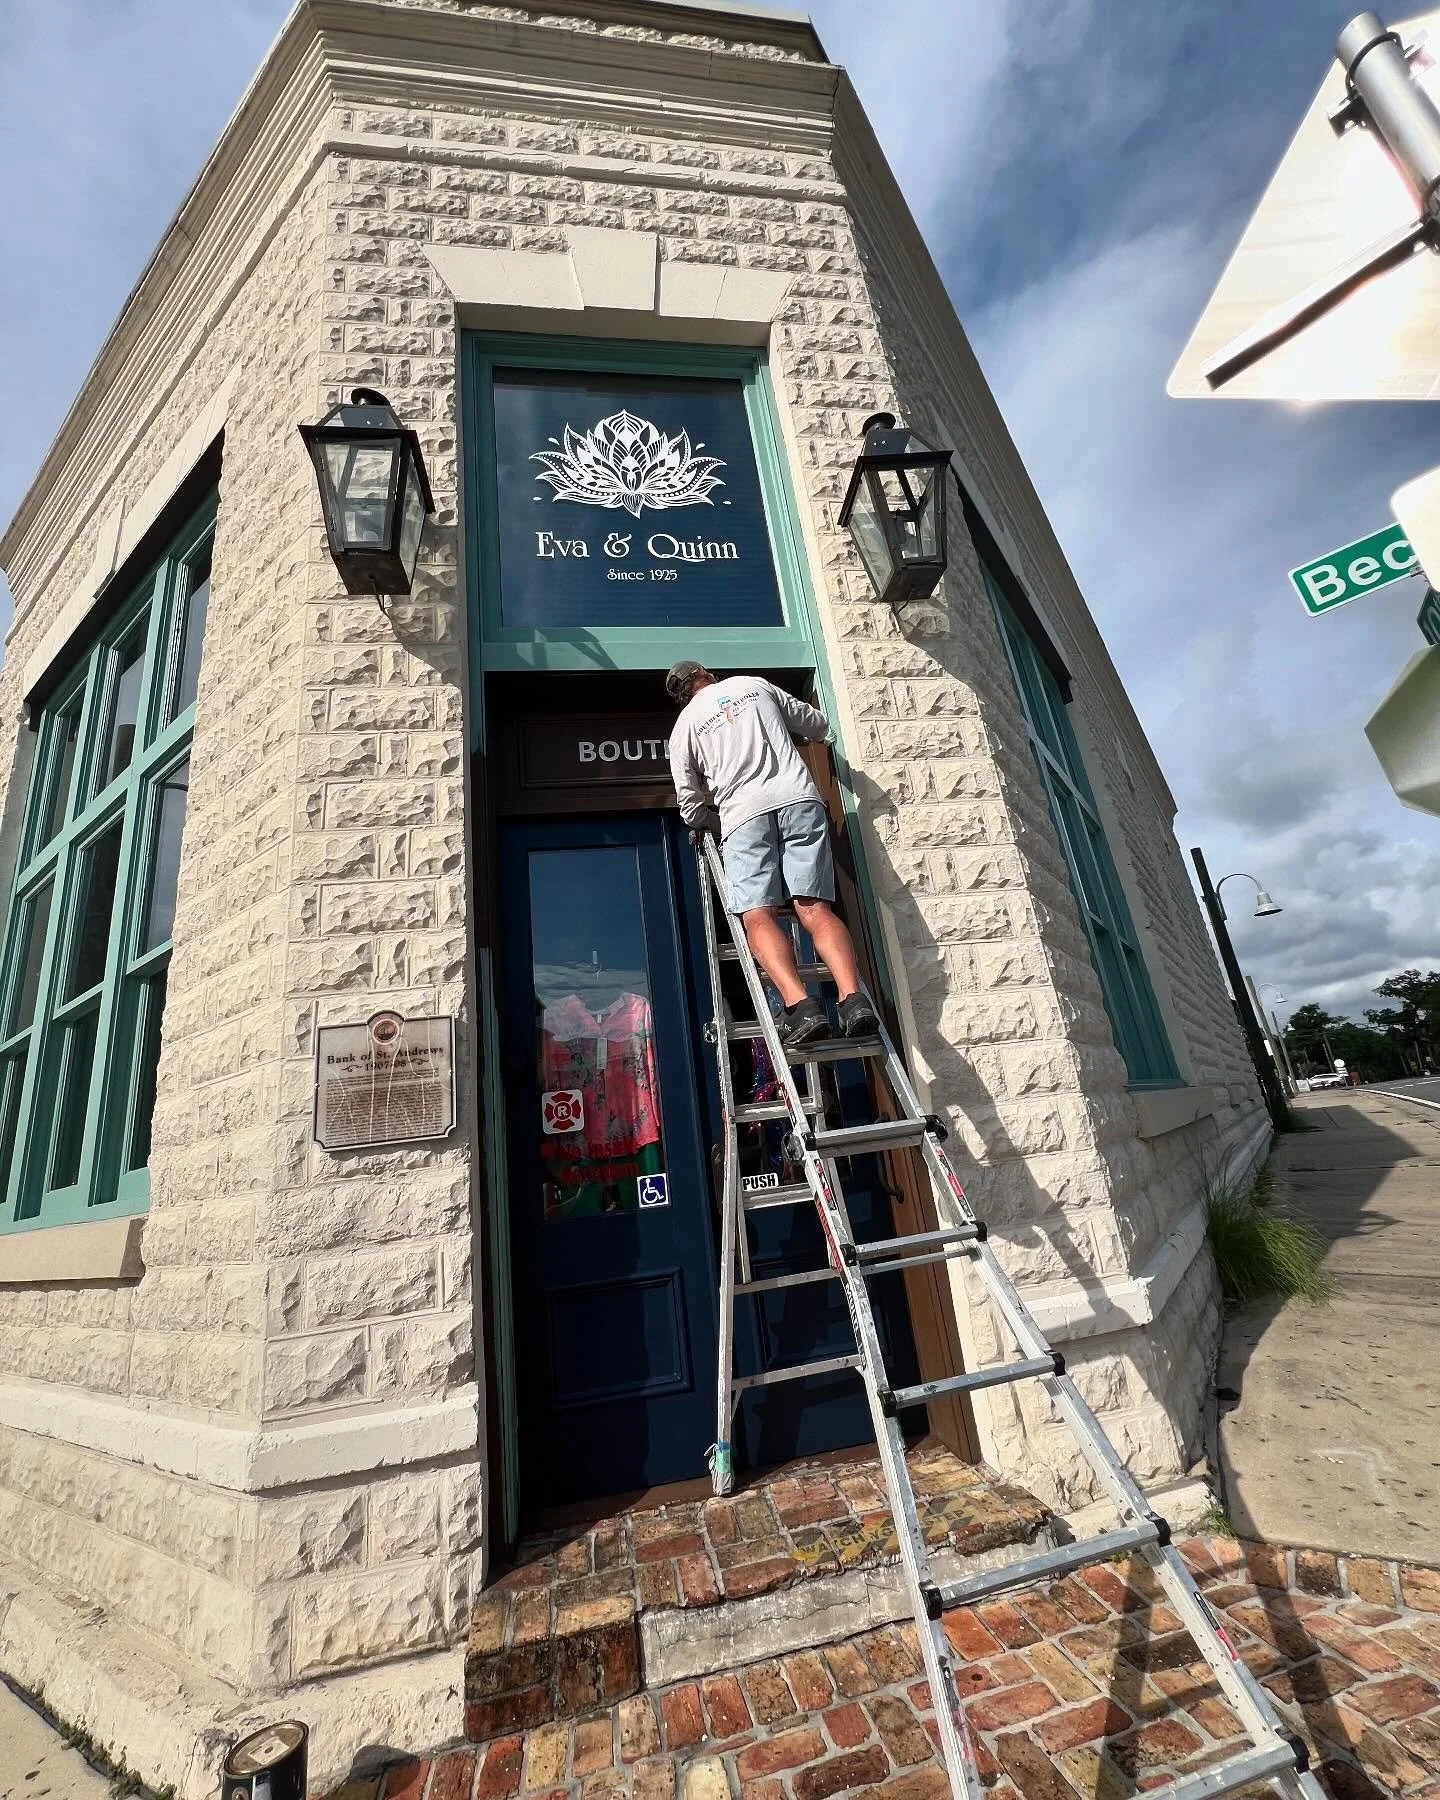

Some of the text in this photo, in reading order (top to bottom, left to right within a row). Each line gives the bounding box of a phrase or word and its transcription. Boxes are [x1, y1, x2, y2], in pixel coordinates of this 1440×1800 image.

[535, 530, 740, 562] Eva & Quinn
[607, 568, 678, 581] Since 1925
[1301, 539, 1419, 606] Bec
[578, 739, 671, 762] BOUTI
[327, 1046, 444, 1064] Bank of St. Andrews
[557, 1105, 569, 1117] R
[742, 1174, 776, 1190] PUSH
[871, 1526, 895, 1541] YO
